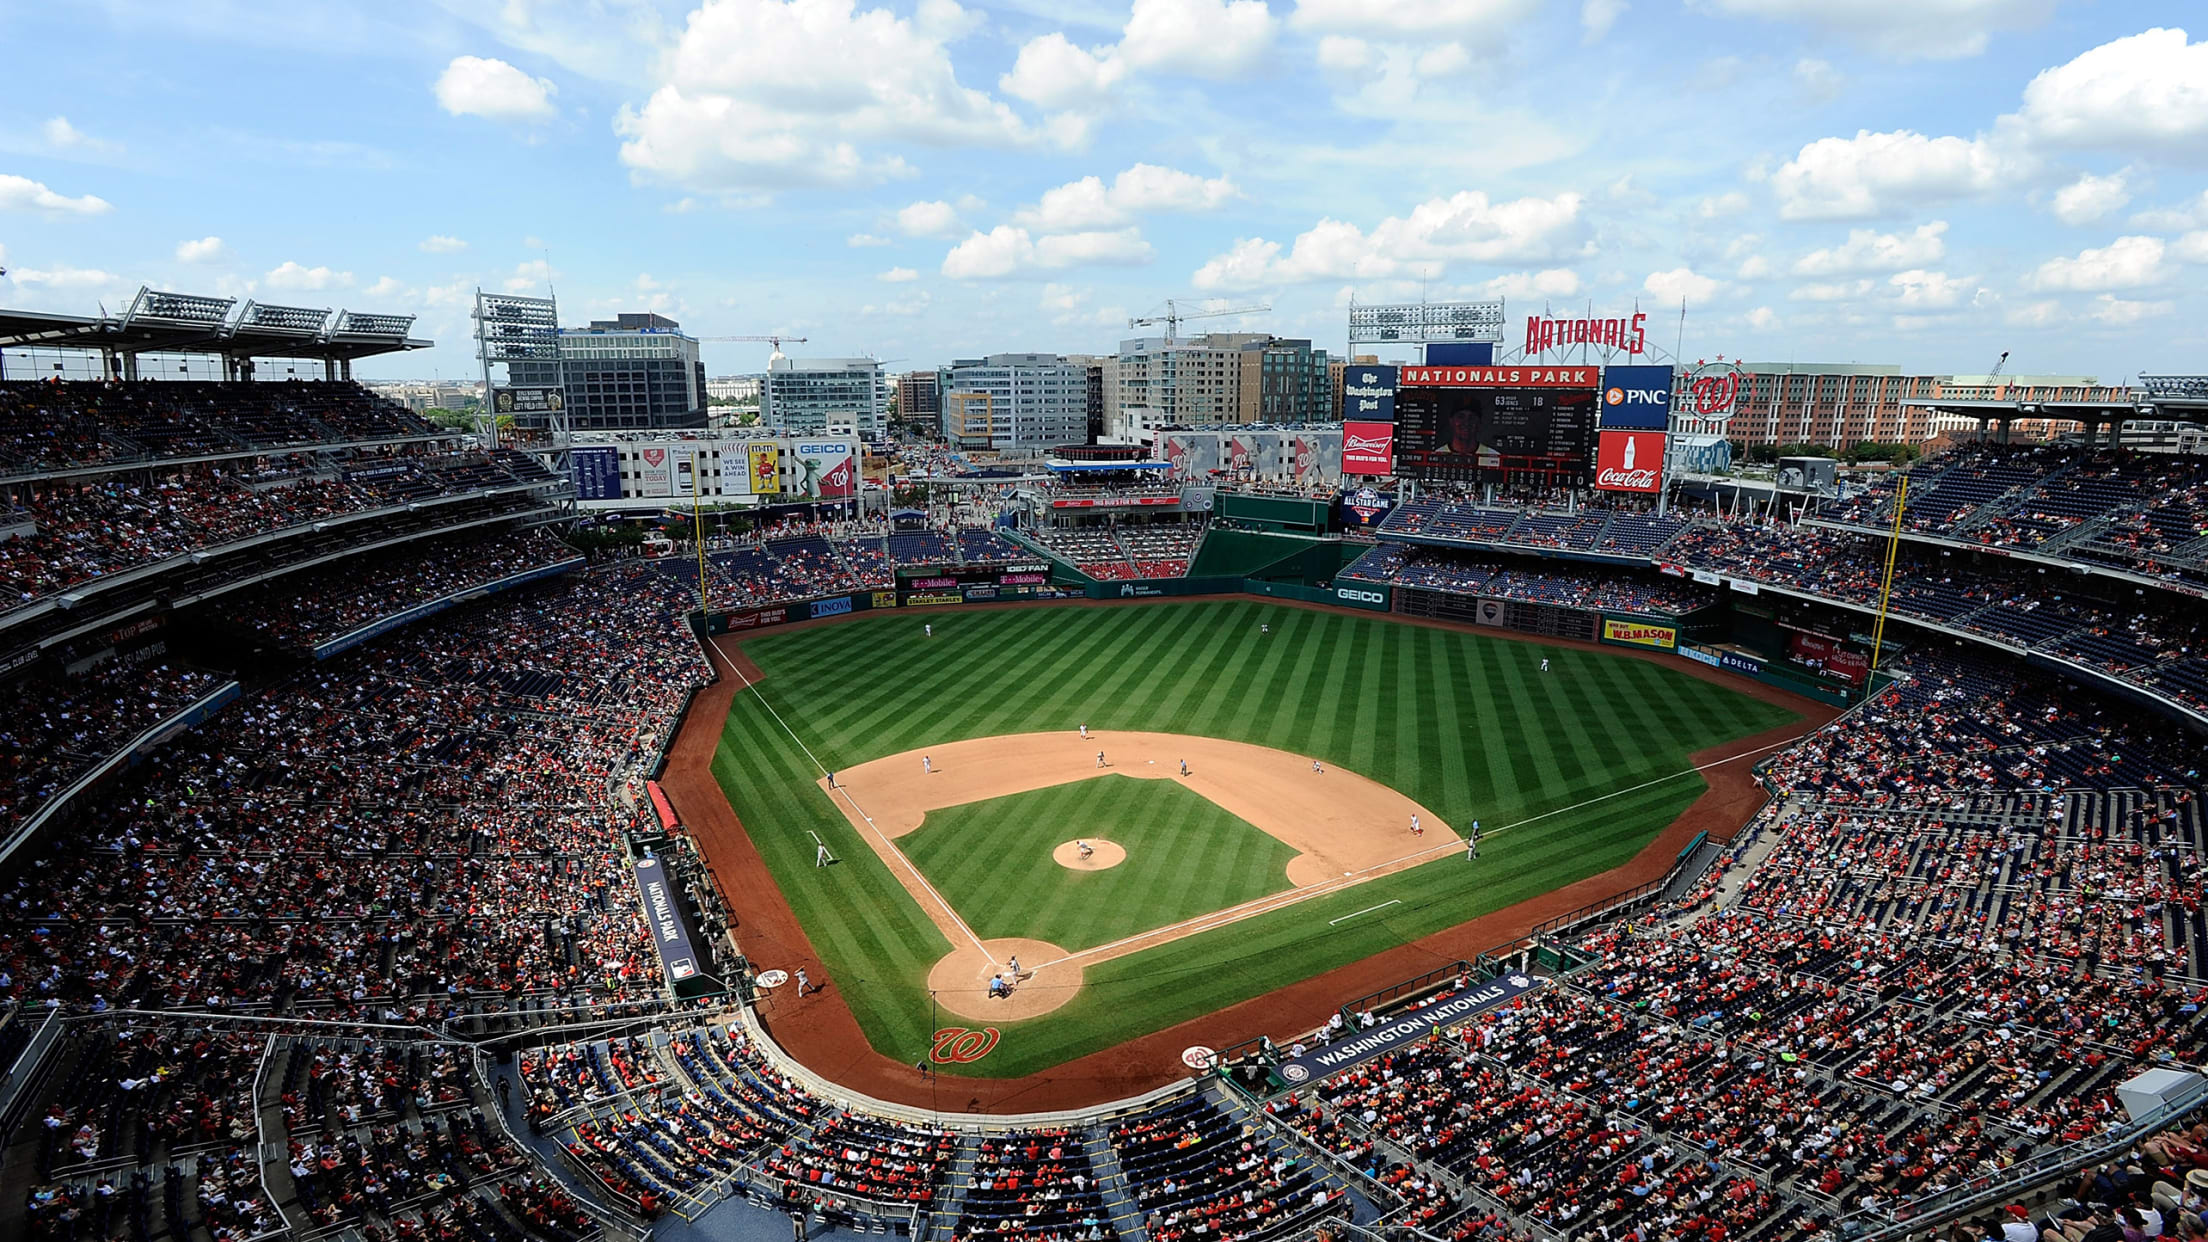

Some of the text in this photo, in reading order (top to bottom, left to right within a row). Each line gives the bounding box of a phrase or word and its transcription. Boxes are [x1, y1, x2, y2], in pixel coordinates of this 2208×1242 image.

[1525, 313, 1647, 355] NATIONALS
[1361, 373, 1378, 383] The
[1407, 370, 1587, 384] NATIONALS PARK
[1346, 386, 1393, 399] Washington
[1626, 389, 1667, 405] PNC
[1692, 372, 1738, 414] W
[1359, 400, 1378, 412] Post
[1495, 395, 1505, 406] 63
[800, 444, 846, 454] GEICO
[1348, 439, 1386, 449] Budweiser
[1598, 467, 1657, 489] Coca-Cola
[1344, 496, 1389, 509] ALL STAR GAME
[1338, 588, 1384, 604] GEICO
[821, 601, 851, 613] INOVA
[1731, 658, 1758, 673] DELTA
[647, 881, 679, 943] NATIONALS PARK
[1315, 985, 1506, 1067] WASHINGTON NATIONALS
